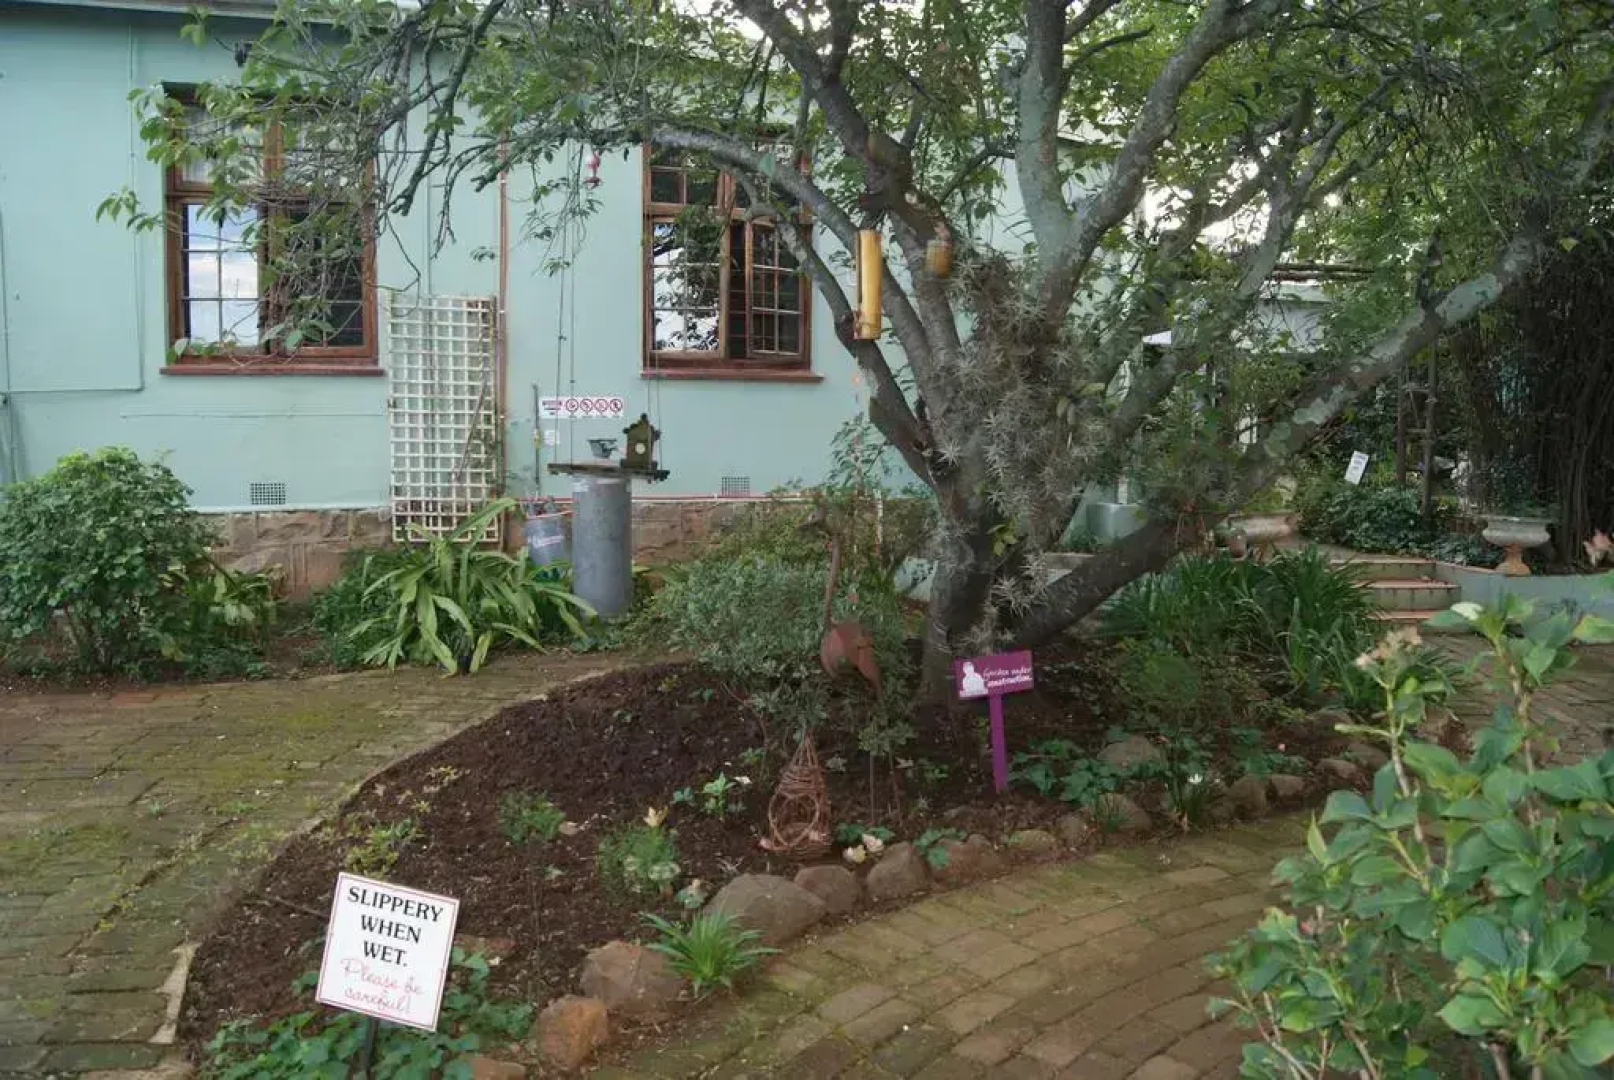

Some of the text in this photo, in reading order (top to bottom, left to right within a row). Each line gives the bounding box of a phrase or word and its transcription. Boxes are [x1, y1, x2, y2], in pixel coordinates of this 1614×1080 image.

[348, 886, 444, 922] SLIPPERY
[361, 914, 421, 944] WHEN
[363, 940, 408, 967] WET.
[340, 958, 424, 995] Please be
[344, 988, 411, 1013] careful!
